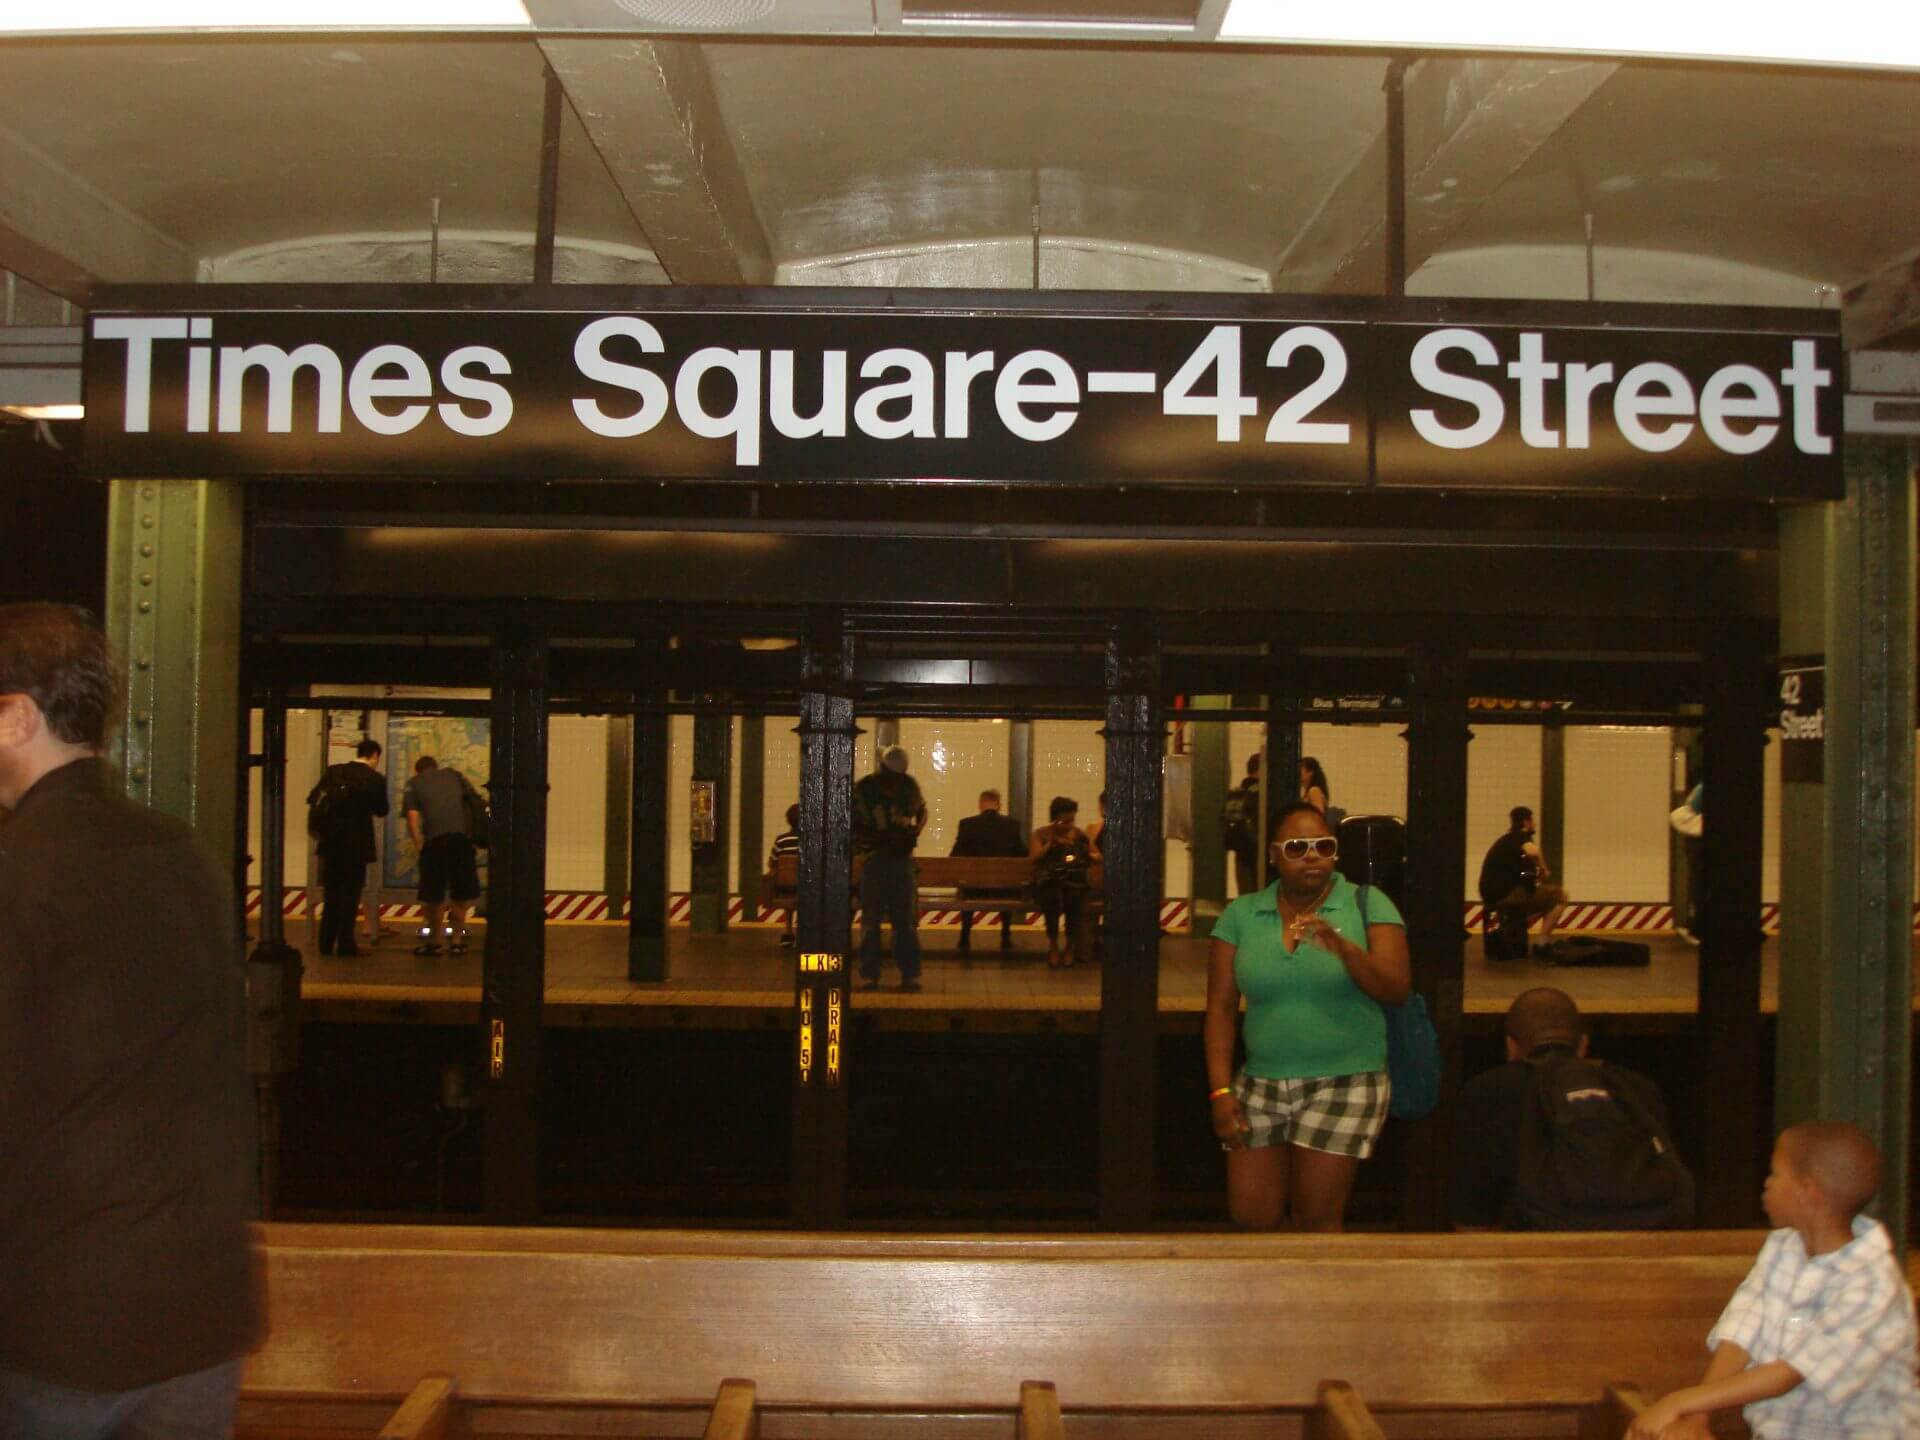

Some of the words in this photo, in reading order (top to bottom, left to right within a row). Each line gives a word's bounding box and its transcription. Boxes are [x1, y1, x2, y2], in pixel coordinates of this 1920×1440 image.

[93, 317, 514, 437] Times
[1409, 328, 1832, 454] Street
[1780, 674, 1801, 705] 42
[1780, 708, 1823, 740] Street
[829, 990, 840, 1085] DRAIN
